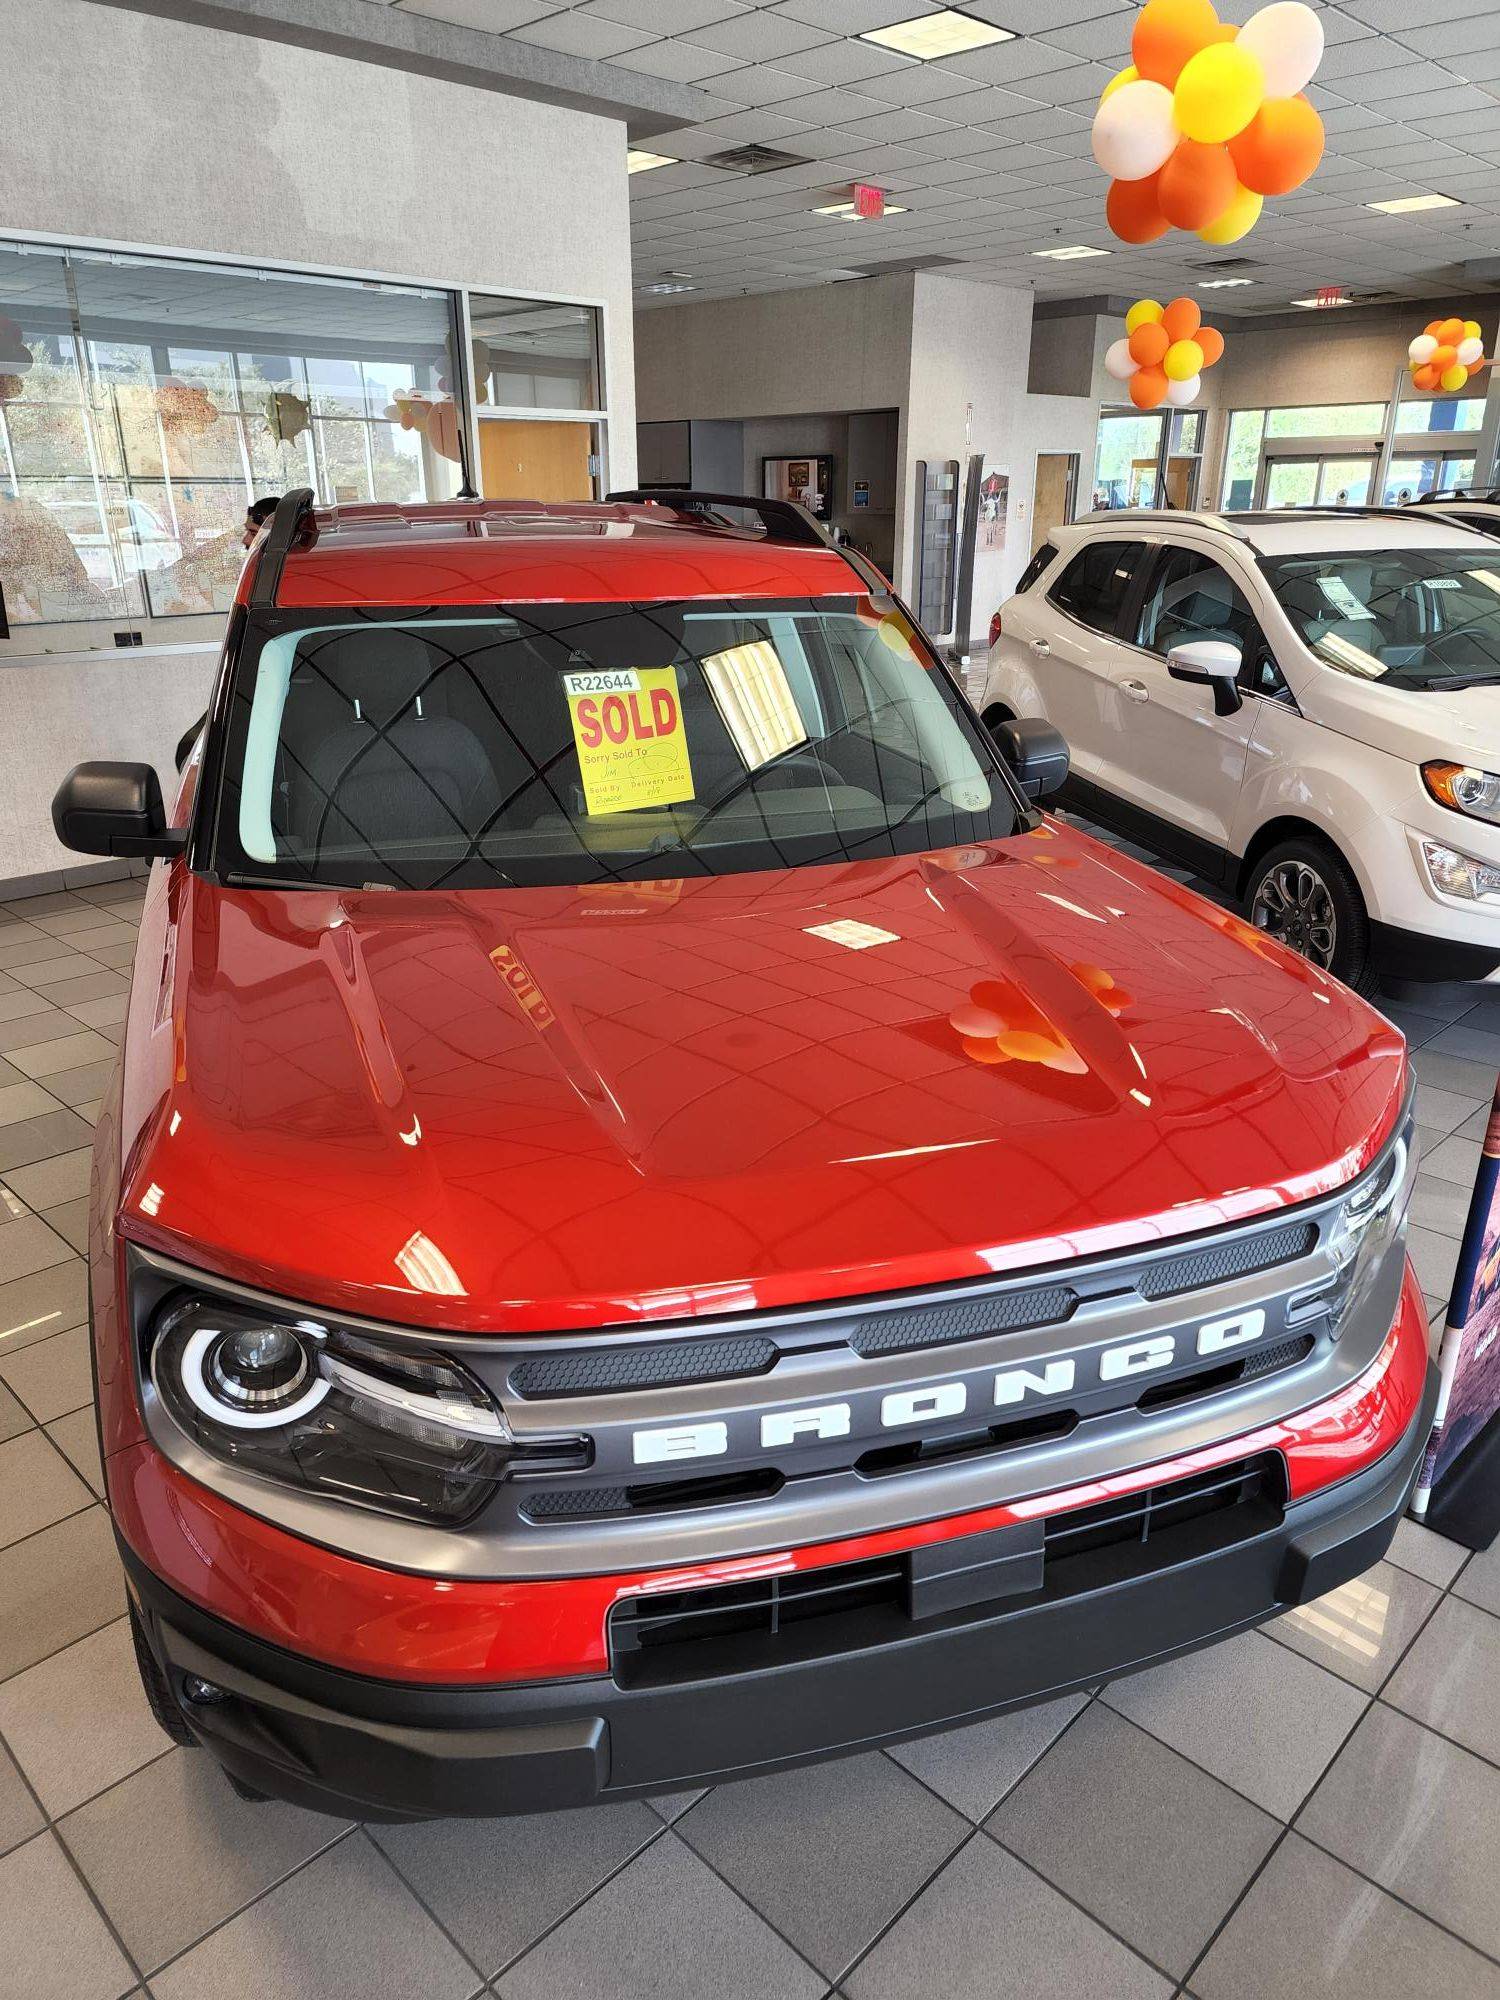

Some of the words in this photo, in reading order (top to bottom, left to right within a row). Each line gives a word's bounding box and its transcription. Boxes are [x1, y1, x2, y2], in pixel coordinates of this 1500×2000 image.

[570, 674, 633, 691] R22644
[577, 688, 677, 748] SOLD
[584, 754, 610, 765] Sorry
[612, 751, 633, 760] Sold
[635, 748, 648, 756] To
[631, 777, 664, 788] Delivery
[667, 774, 685, 782] Date
[590, 786, 607, 794] Sold
[632, 1308, 1266, 1464] BRONCO
